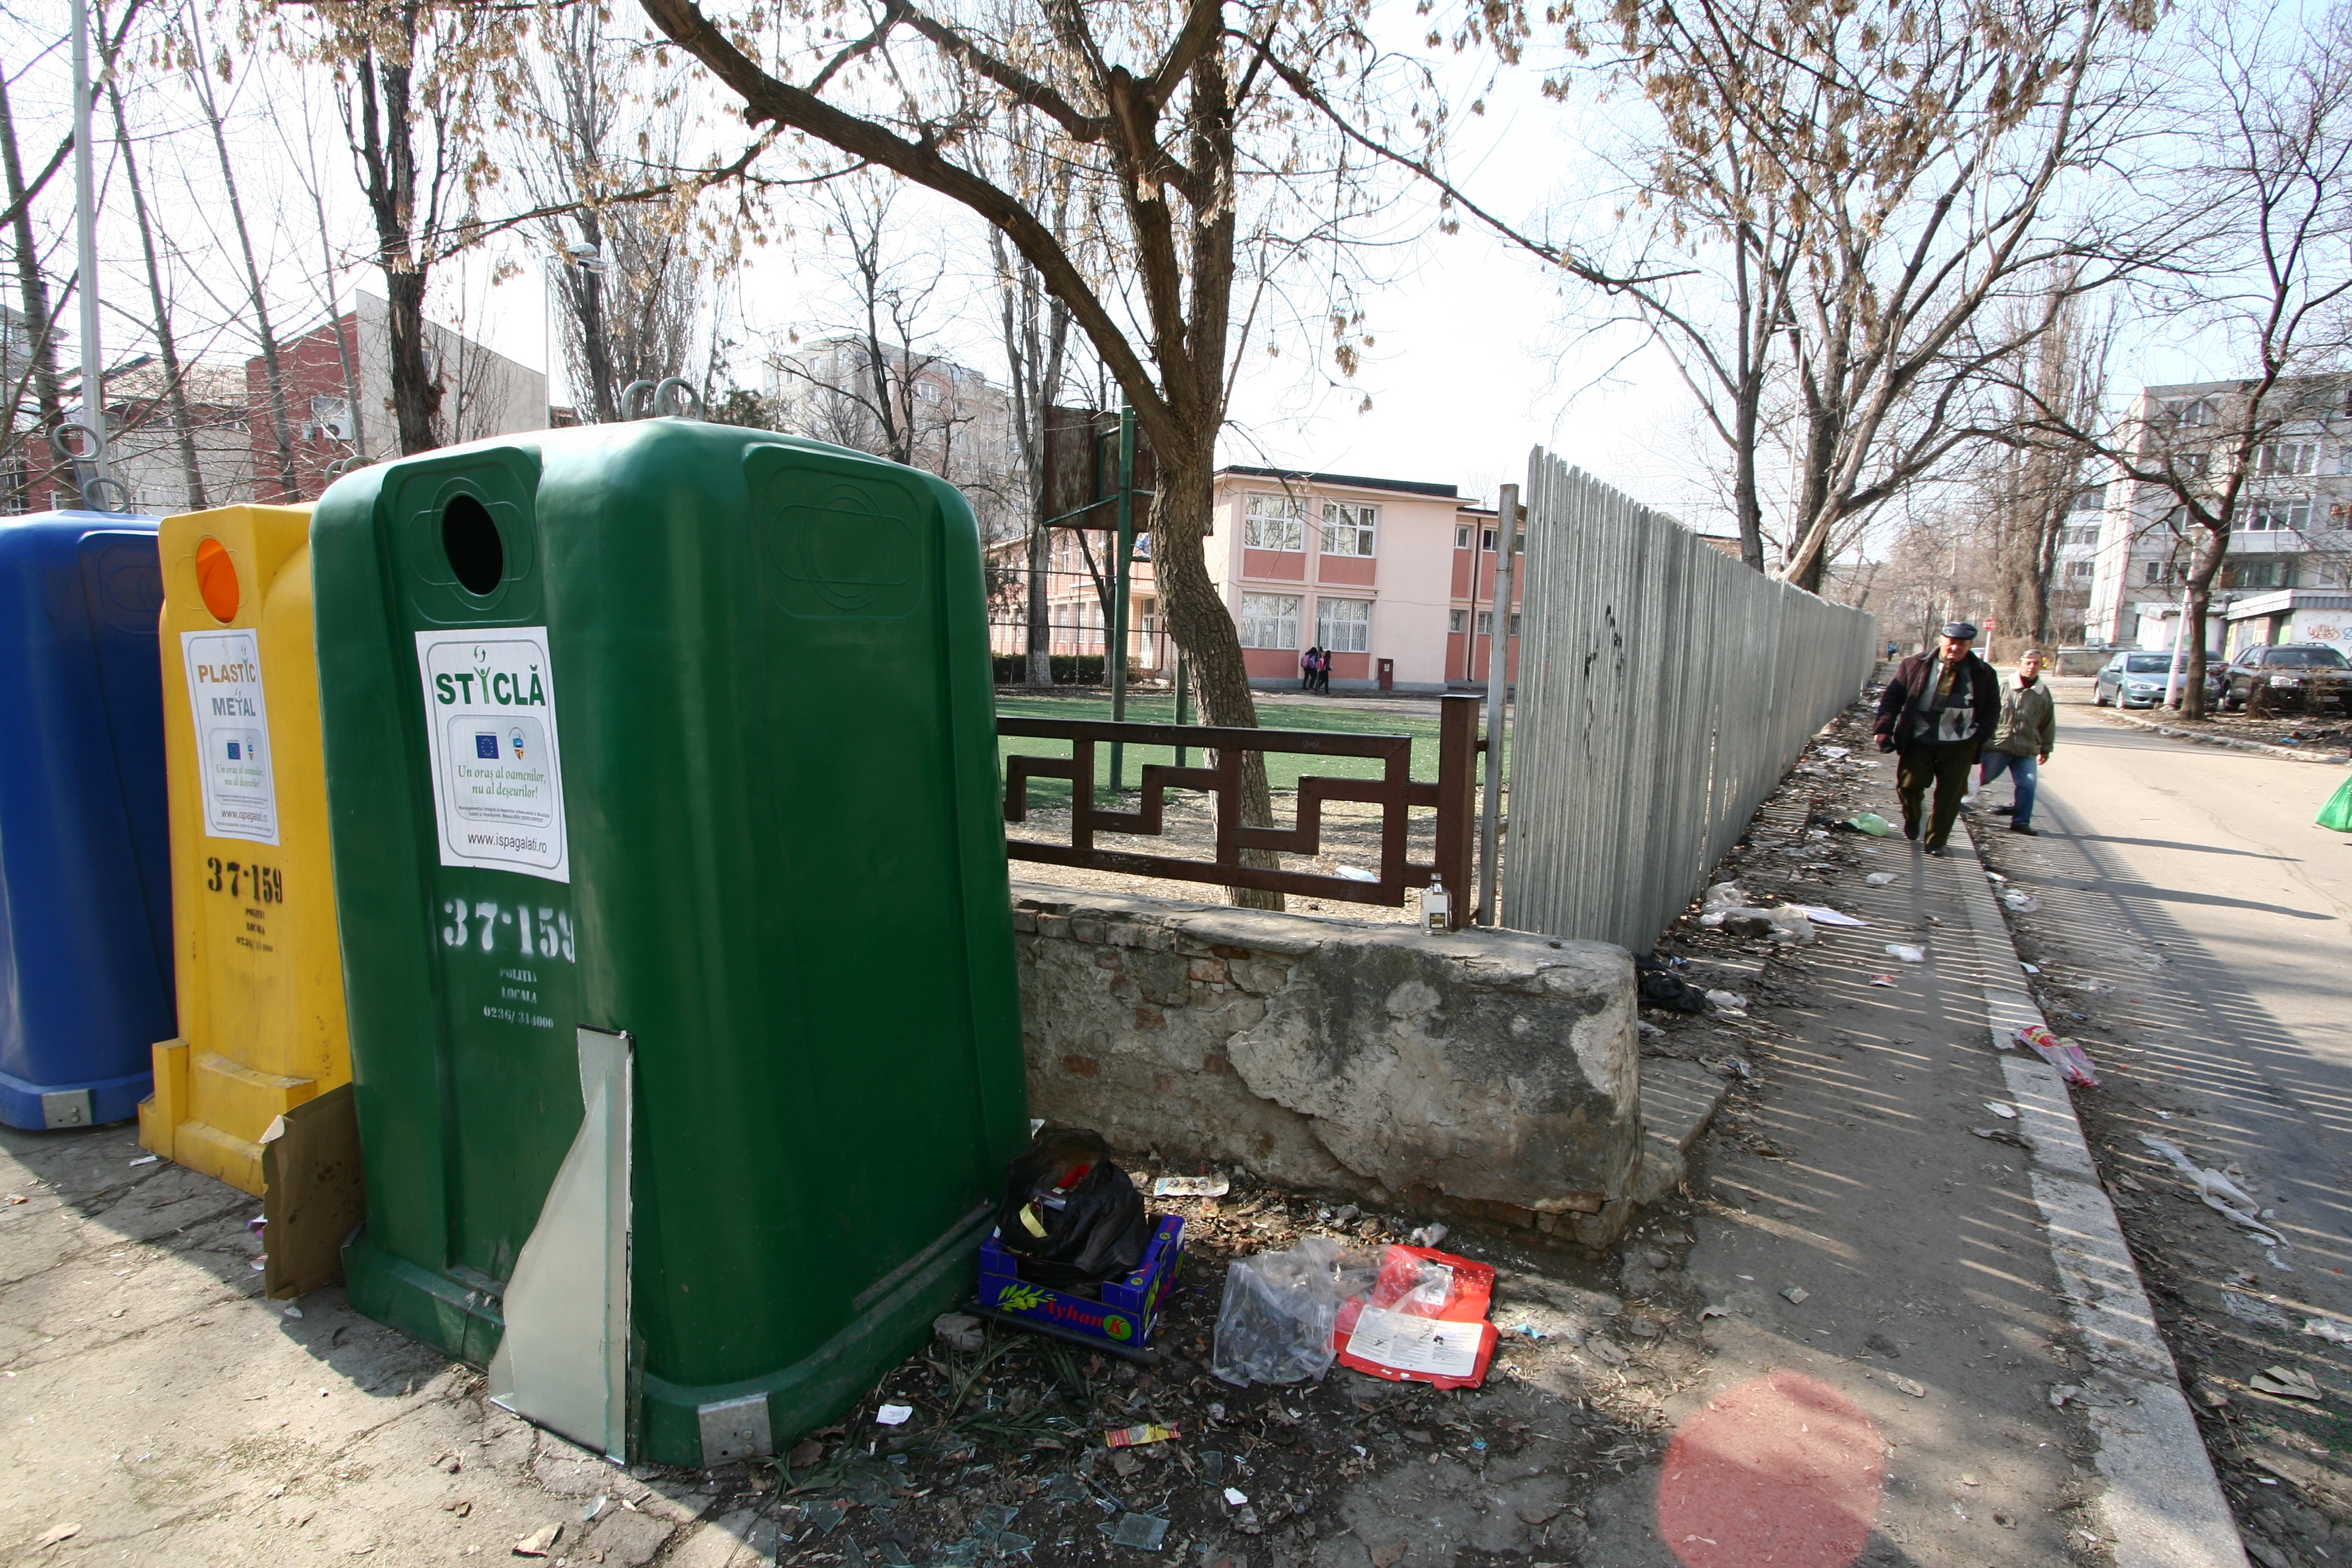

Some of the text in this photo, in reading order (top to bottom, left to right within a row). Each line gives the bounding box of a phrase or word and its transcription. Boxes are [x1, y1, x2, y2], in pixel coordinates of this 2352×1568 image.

[212, 698, 257, 717] METAL
[458, 765, 472, 777] Un
[495, 766, 504, 779] al
[472, 785, 484, 794] nu
[486, 782, 495, 795] al
[468, 832, 547, 853] www.ispagalati.ro
[502, 986, 537, 1004] LOCALA
[1040, 1299, 1126, 1336] Ayhan K
